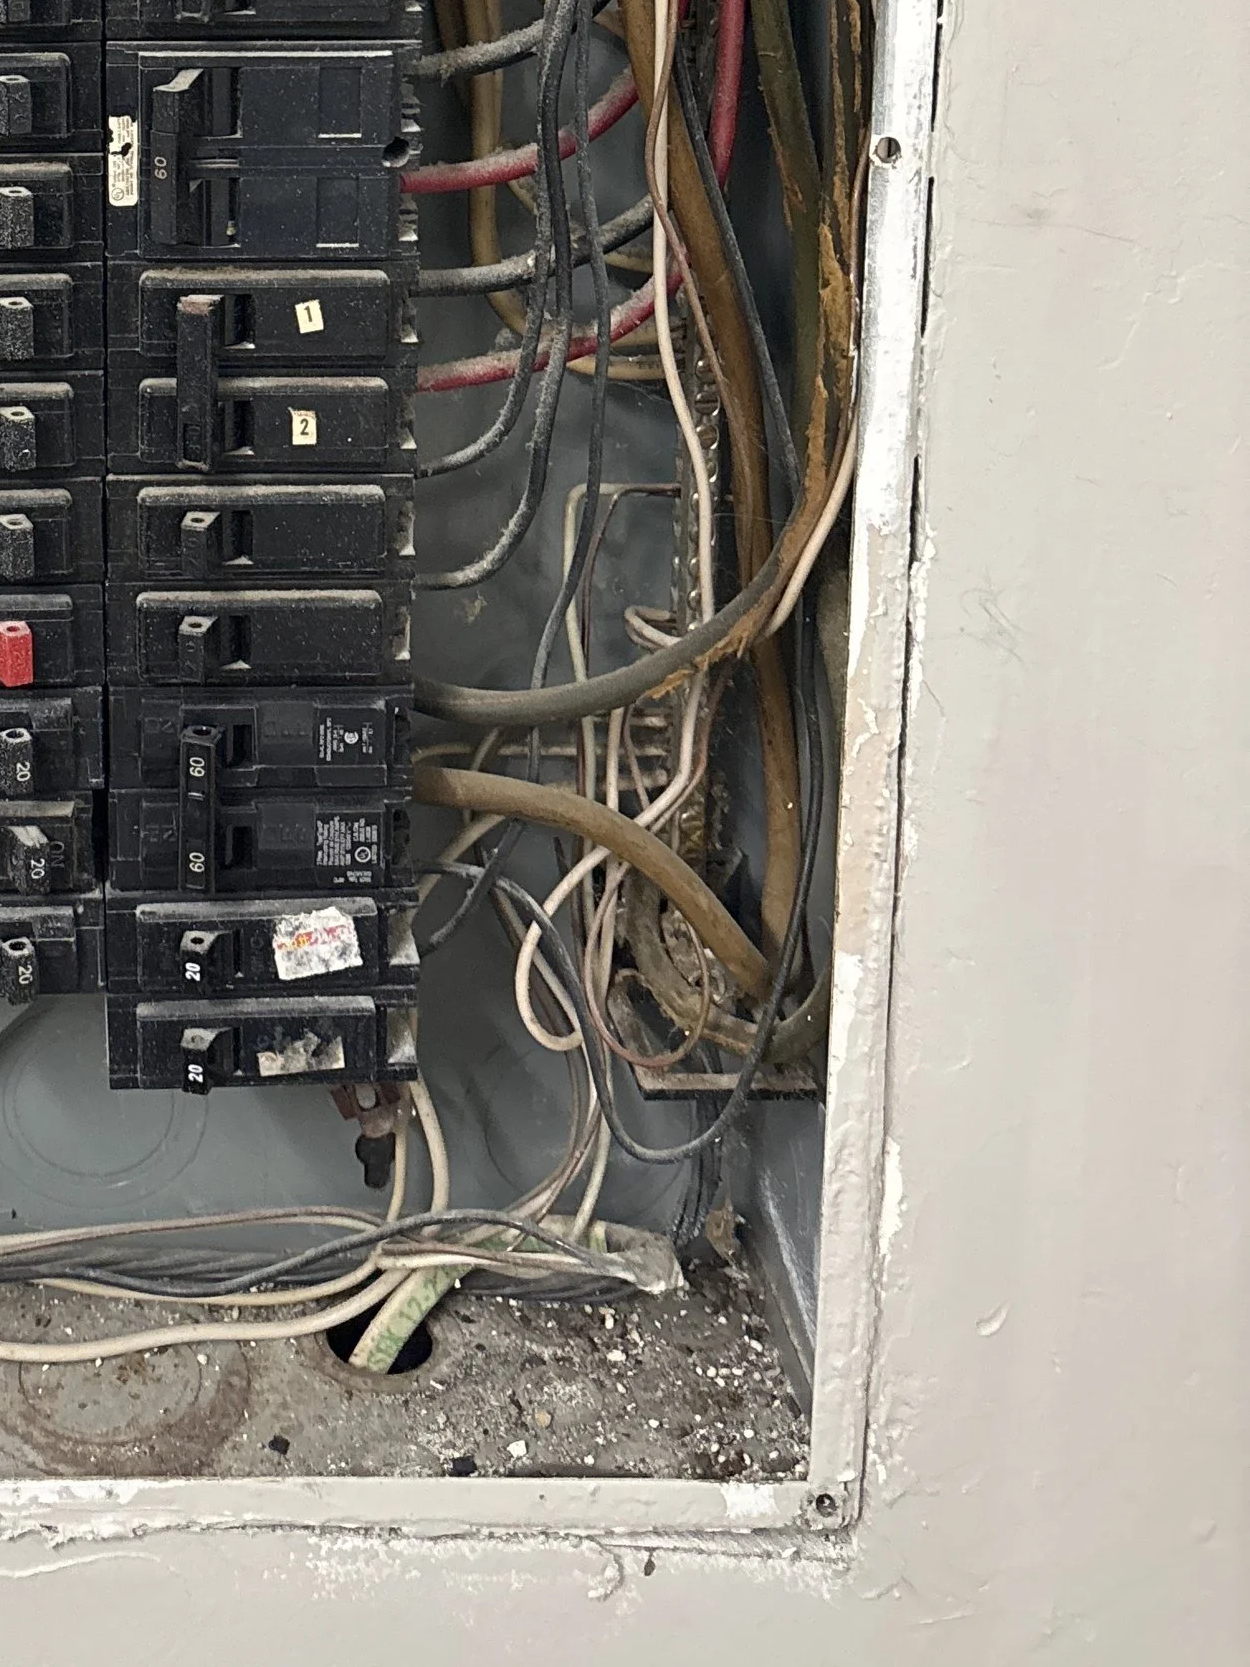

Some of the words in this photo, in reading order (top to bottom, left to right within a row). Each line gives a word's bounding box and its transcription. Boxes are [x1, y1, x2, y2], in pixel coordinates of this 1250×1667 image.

[154, 156, 168, 181] 60
[303, 305, 314, 323] 1
[299, 418, 309, 436] 2
[16, 760, 31, 781] 20
[189, 757, 205, 777] 60
[50, 840, 65, 868] ON
[189, 852, 205, 873] 60
[30, 858, 45, 879] 20
[18, 963, 33, 985] 20
[185, 962, 201, 982] 20
[188, 1064, 204, 1083] 20
